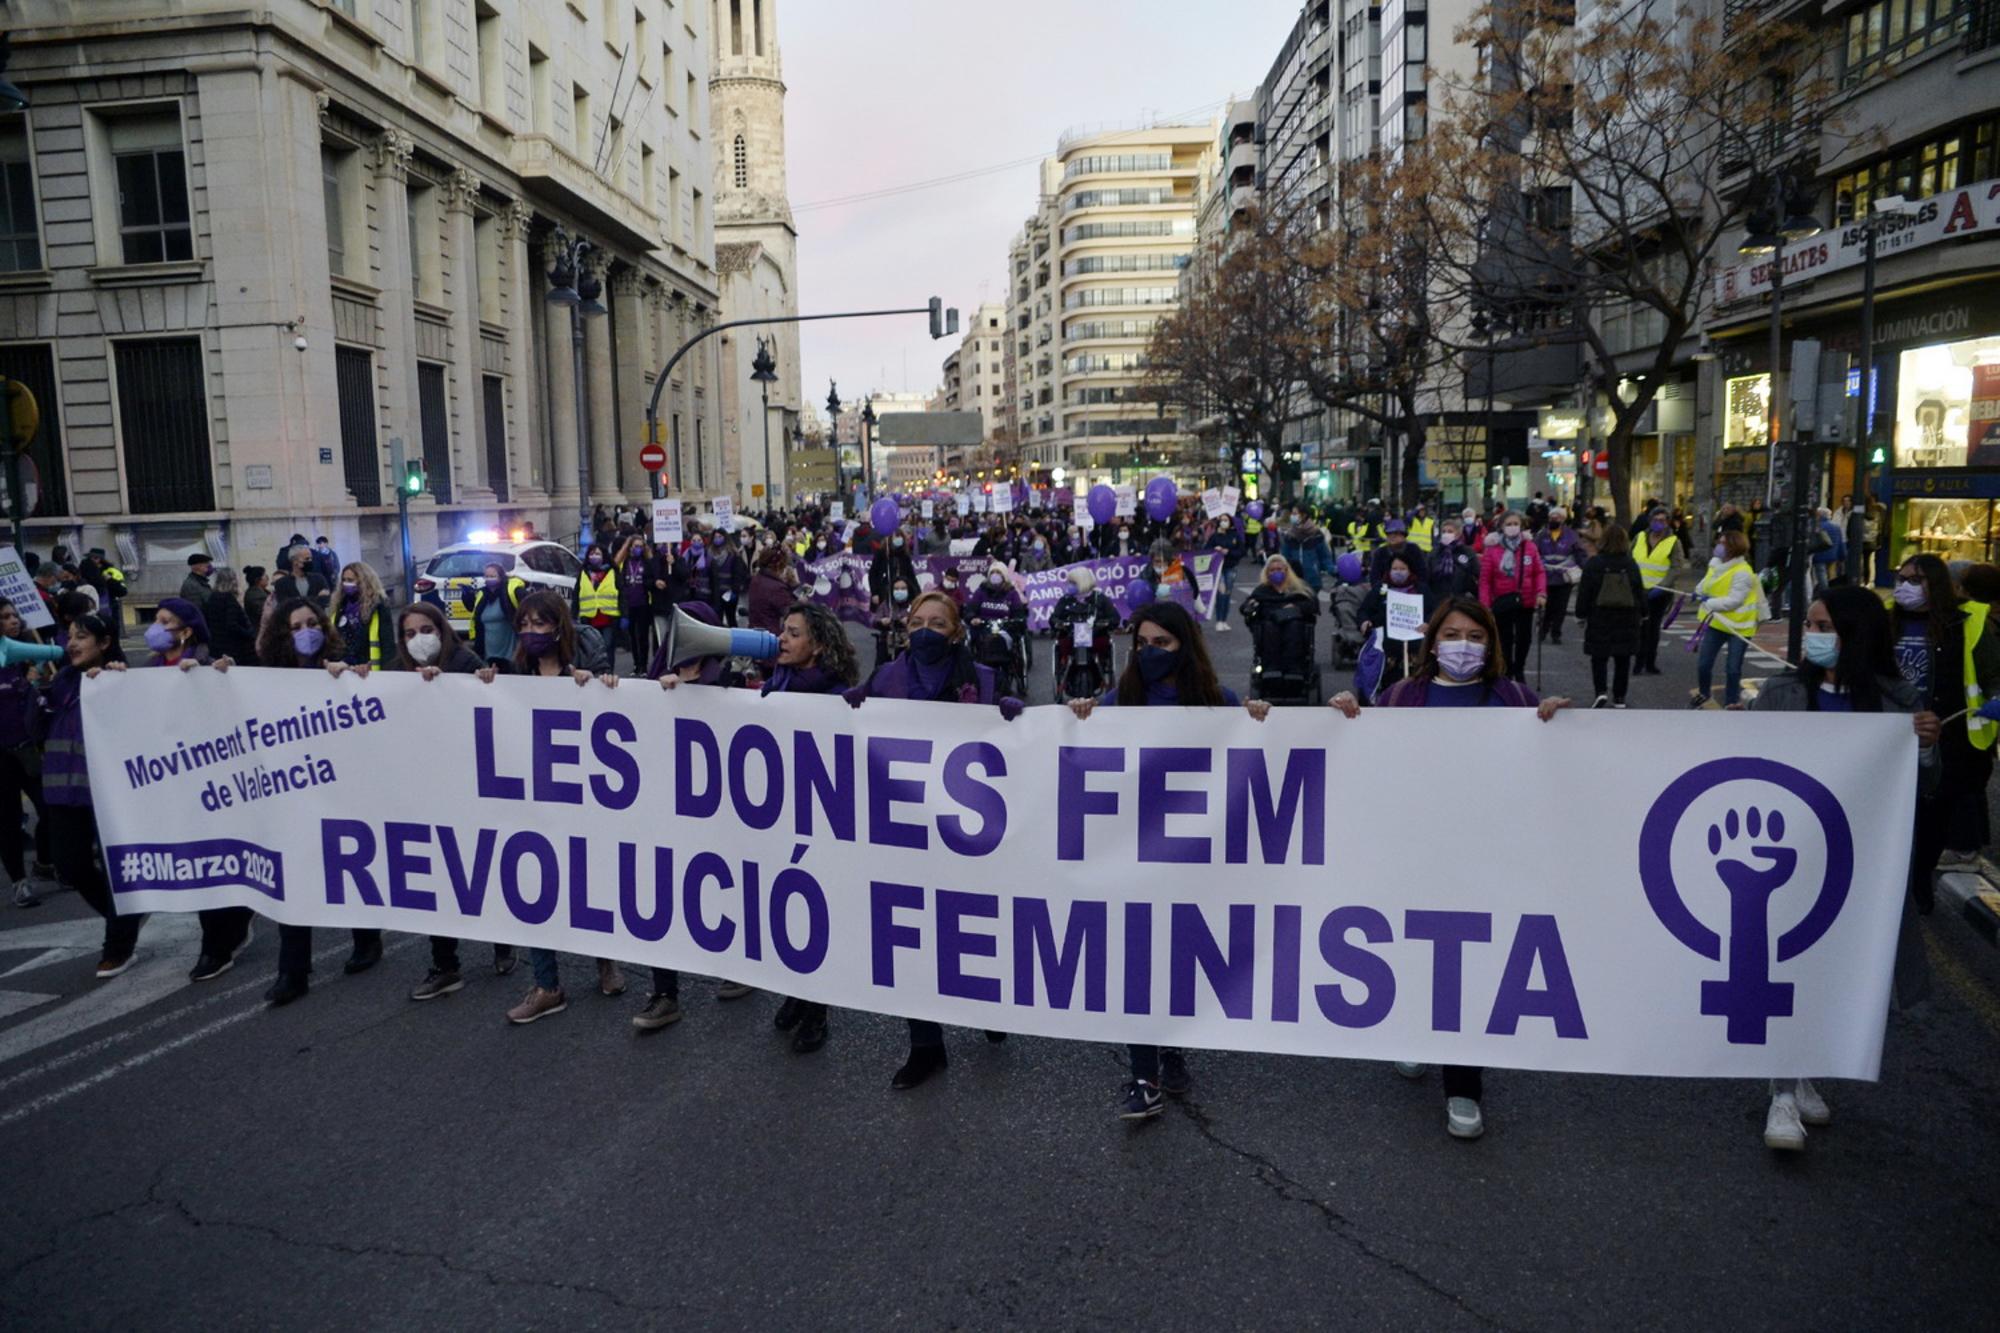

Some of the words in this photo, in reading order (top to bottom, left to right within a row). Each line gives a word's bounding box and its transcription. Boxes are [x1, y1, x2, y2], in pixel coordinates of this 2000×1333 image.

[1841, 202, 1938, 249] ASCNSORES
[1871, 305, 1969, 345] LUMINACIÓN
[124, 724, 246, 789] Moviment
[246, 694, 386, 751] Feminista
[200, 781, 232, 812] de
[232, 754, 337, 804] València
[475, 708, 639, 809] LES
[675, 719, 1006, 857] DONES
[1058, 747, 1326, 865] FEM
[120, 852, 239, 883] #8Marzo
[241, 850, 276, 889] 2022
[321, 820, 830, 974] REVOLUCIÓ
[871, 882, 1588, 1039] FEMINISTA
